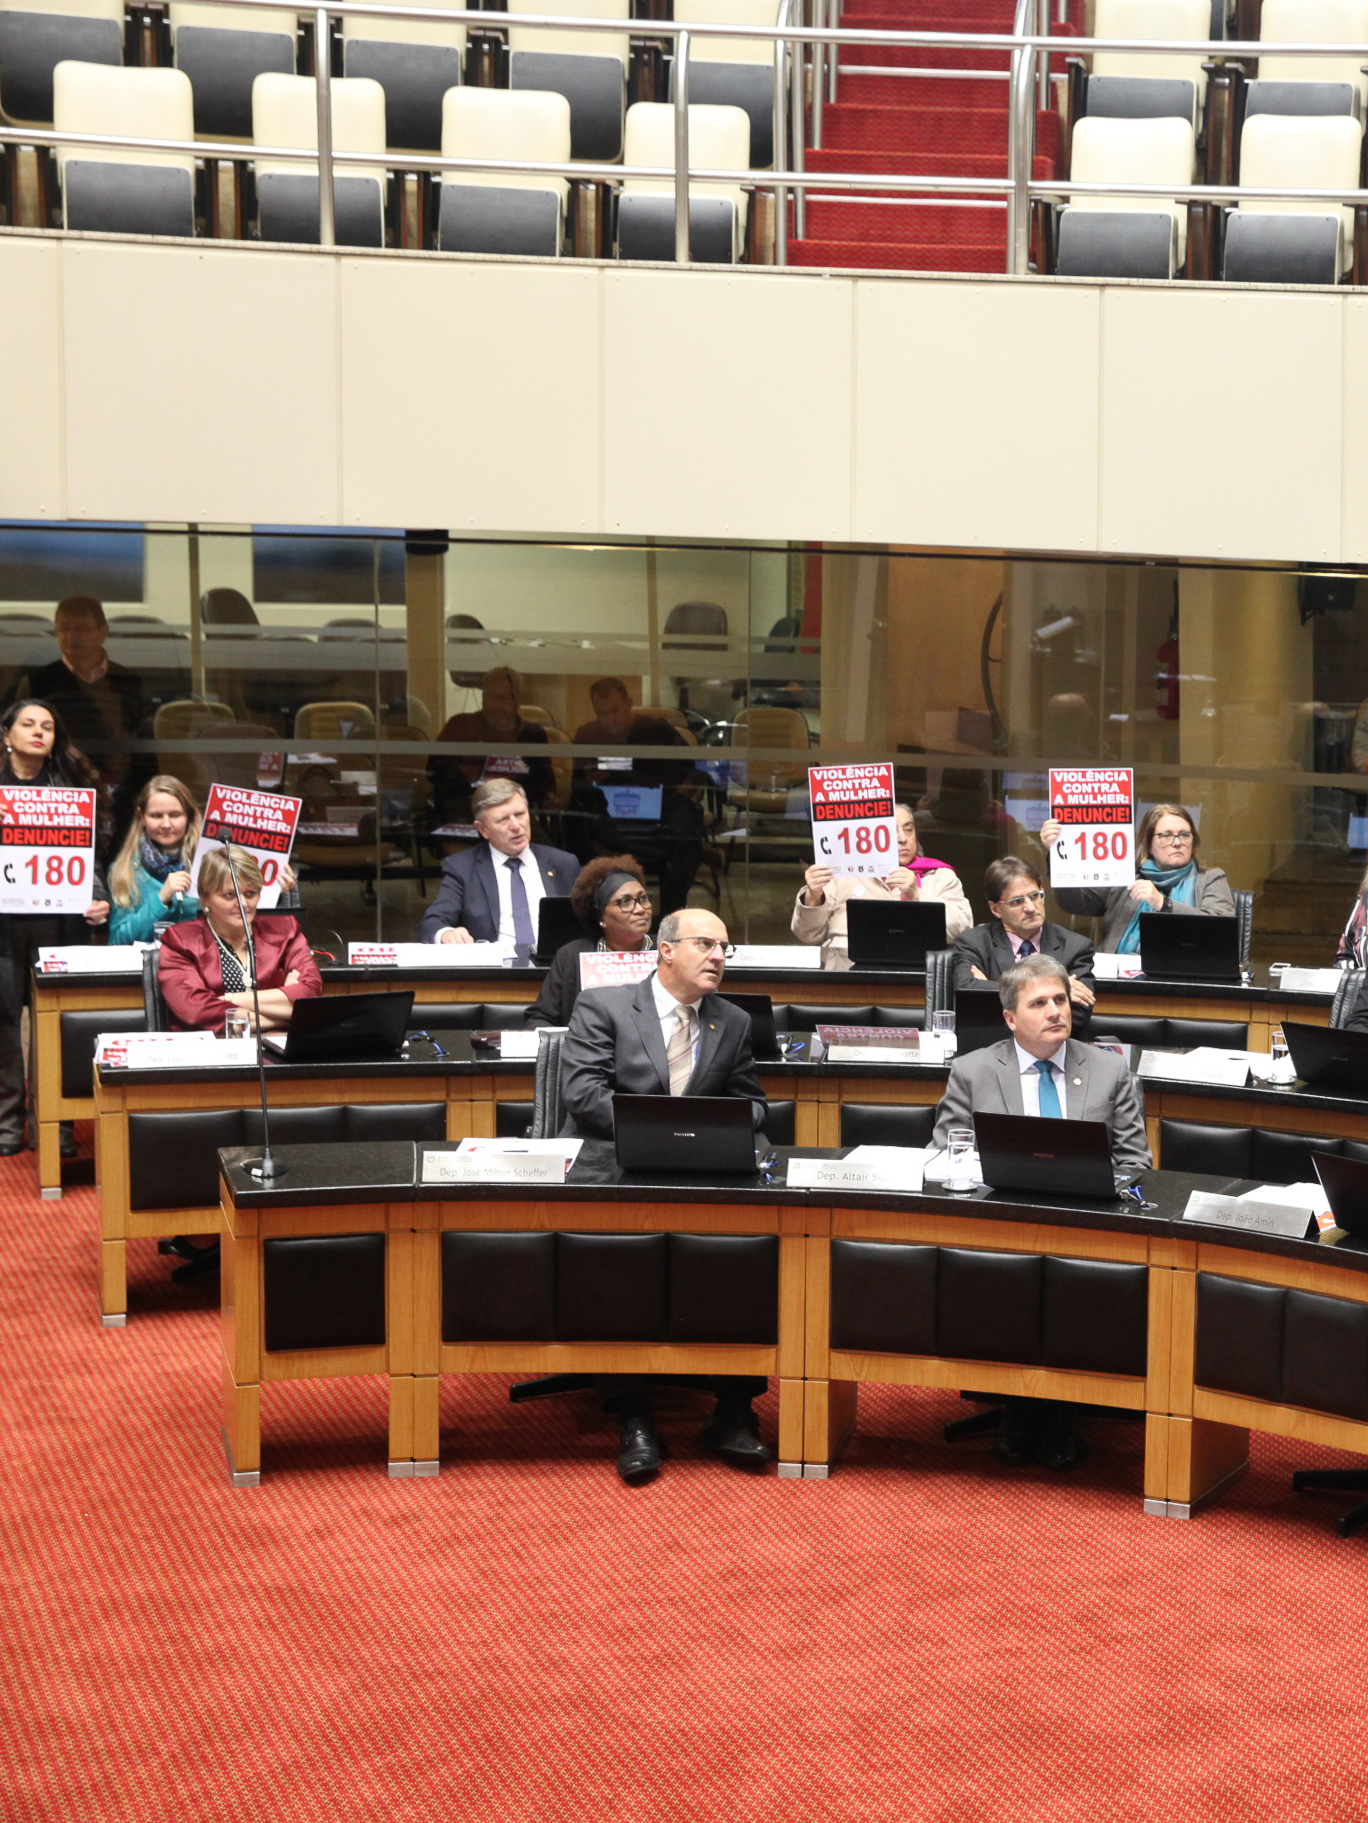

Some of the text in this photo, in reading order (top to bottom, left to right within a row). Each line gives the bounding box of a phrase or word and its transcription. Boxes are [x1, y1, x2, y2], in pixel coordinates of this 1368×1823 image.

[813, 766, 889, 780] VIOLÊNCIA
[1054, 770, 1128, 782] VIOLÊNCIA
[823, 778, 880, 790] CONTRA
[1062, 782, 1120, 793] CONTRA
[3, 788, 90, 803] VIOLÊNCIA
[215, 787, 294, 811] VIOLÊNCIA
[815, 788, 890, 802] A MULHER:
[1054, 793, 1129, 804] A MULHER:
[13, 802, 80, 814] CONTRA
[222, 801, 283, 820] CONTRA
[815, 801, 892, 820] DENUNCIE!
[1054, 807, 1130, 823] DENUNCIE!
[2, 813, 91, 826] A MULHER:
[210, 810, 291, 833] A MULHER:
[2, 828, 91, 846] DENUNCIE!
[206, 822, 289, 851] DNUNCIE!
[838, 824, 890, 854] 180
[1074, 831, 1127, 861] 180
[25, 855, 85, 886] 180
[586, 952, 656, 964] VIOLÊNC
[587, 975, 599, 986] A
[440, 1168, 460, 1179] Dep.
[514, 1168, 548, 1178] Scheffer
[817, 1171, 839, 1181] Dep.
[842, 1172, 869, 1181] Altair
[1216, 1210, 1275, 1227] Dep. João Amin
